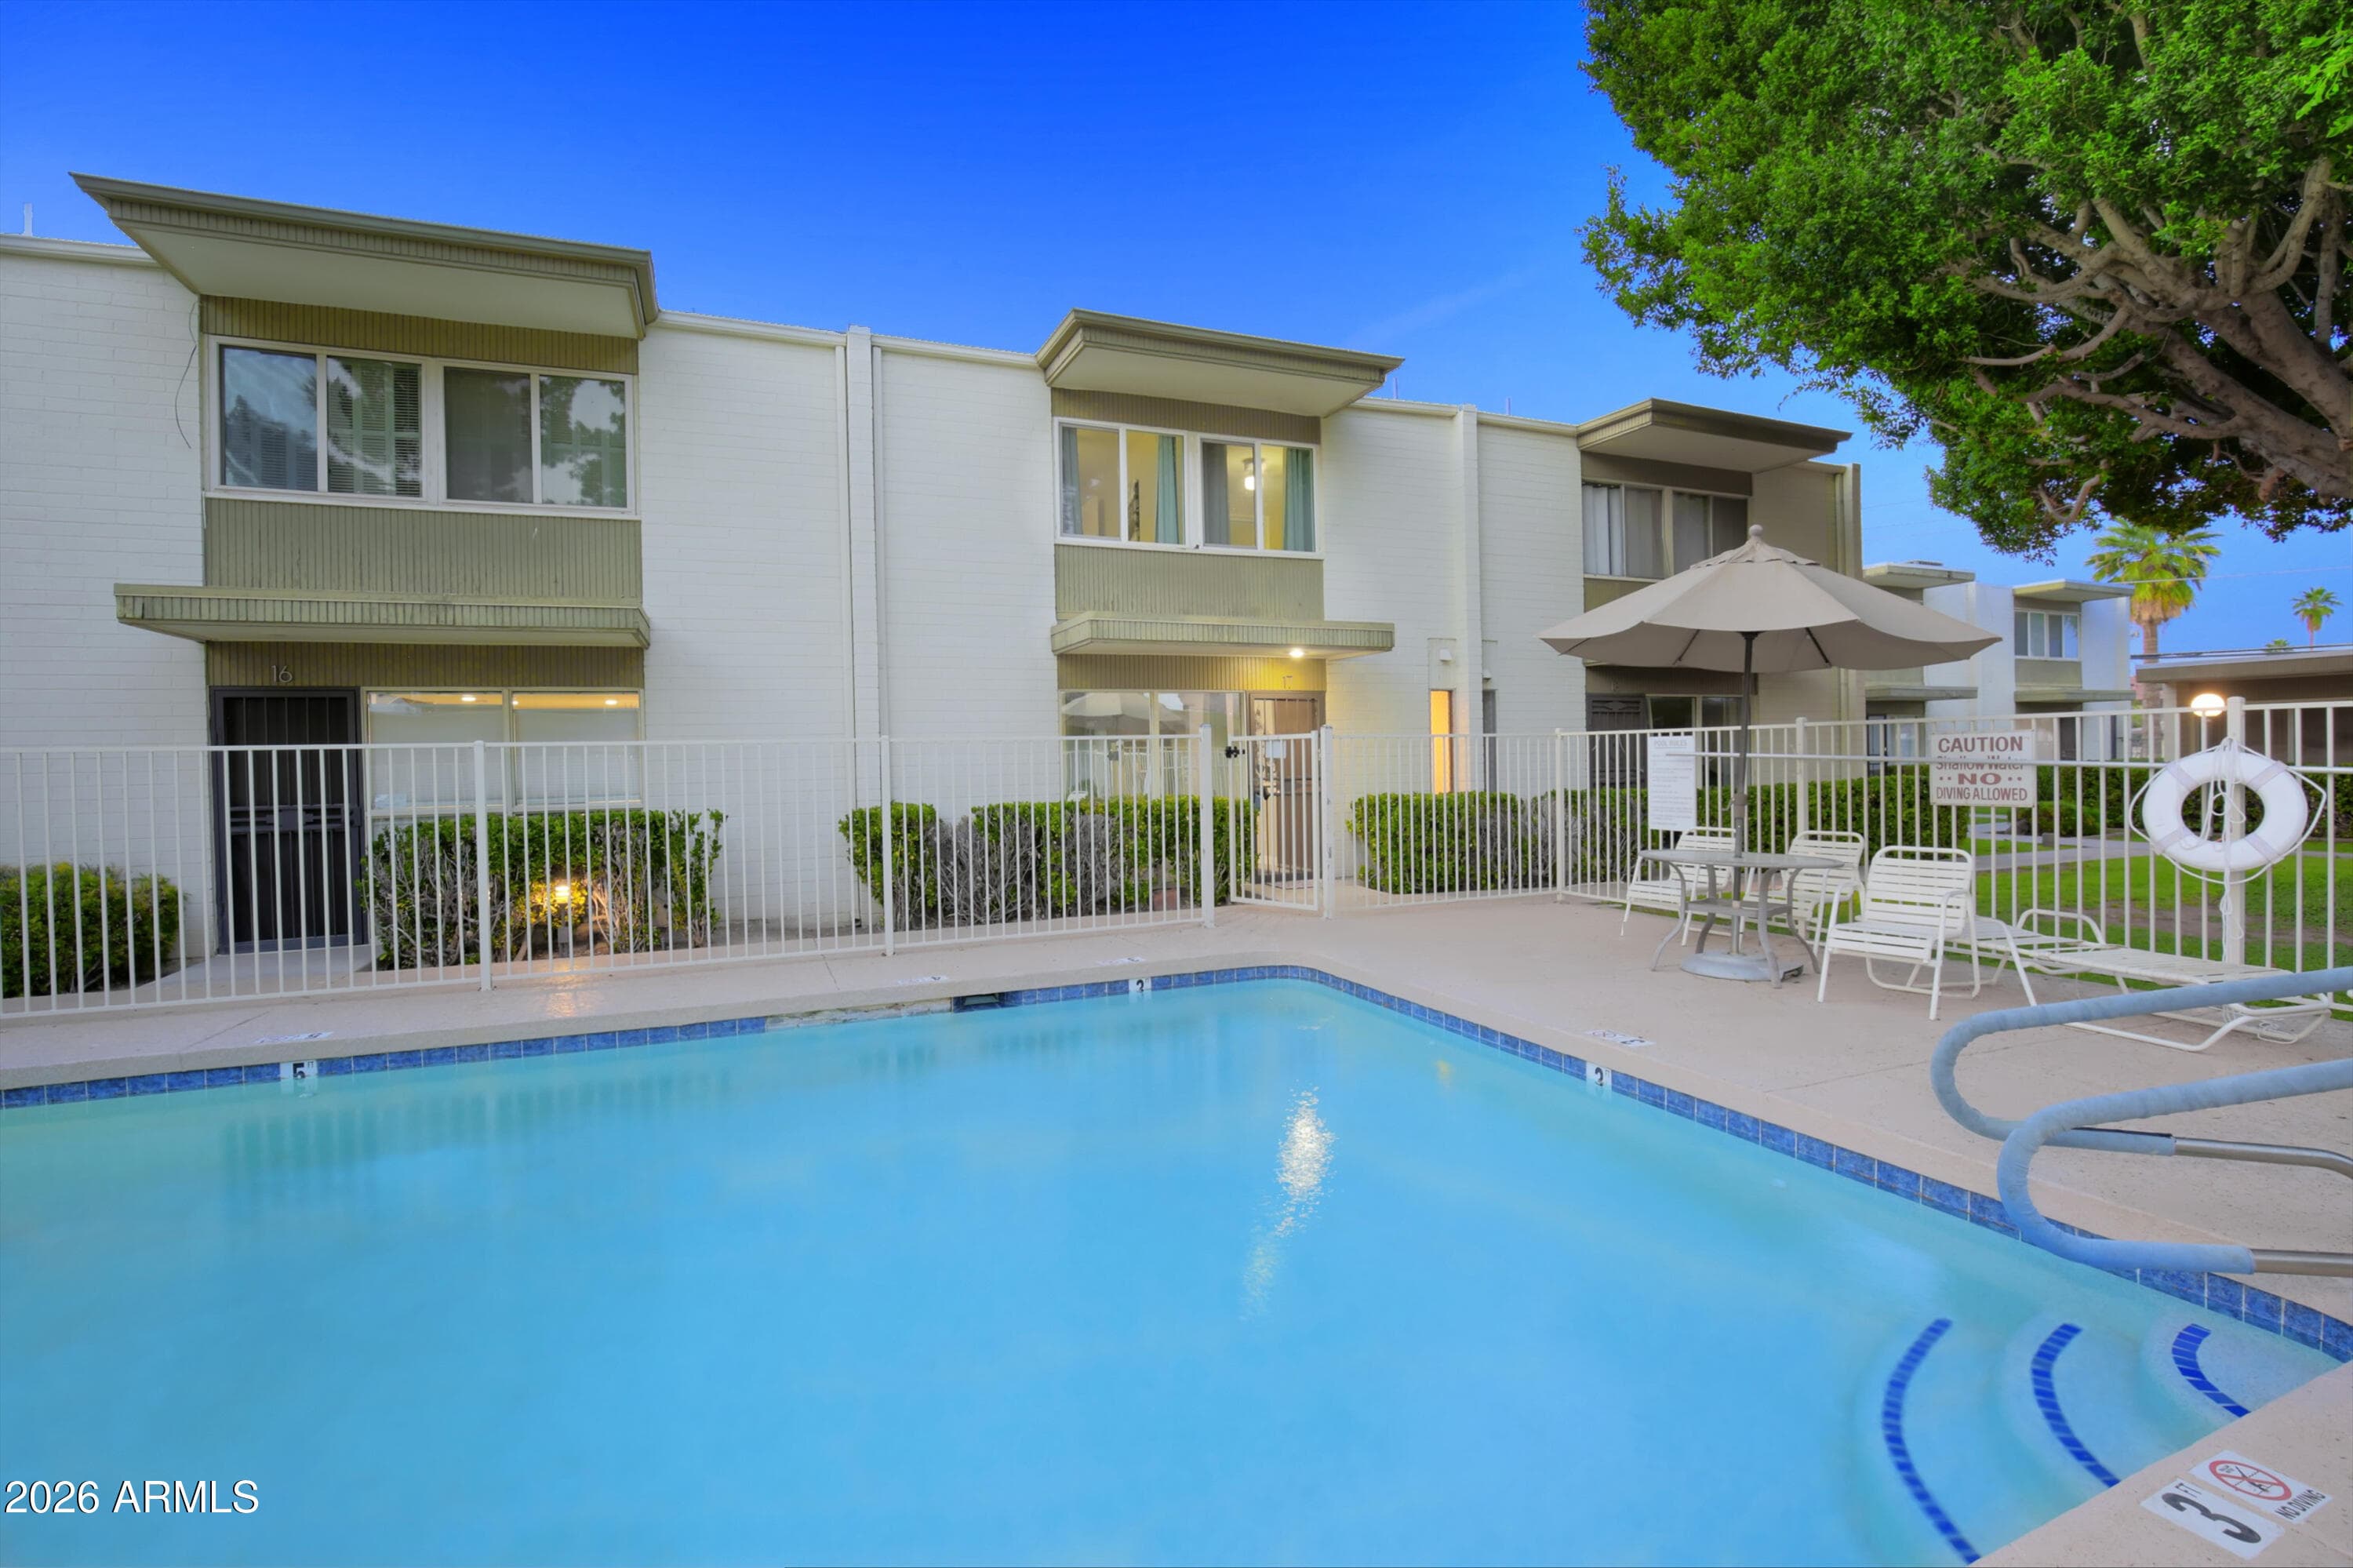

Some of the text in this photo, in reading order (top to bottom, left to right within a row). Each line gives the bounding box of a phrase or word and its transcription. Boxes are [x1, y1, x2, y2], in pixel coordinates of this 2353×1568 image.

[271, 665, 293, 683] 16
[1938, 736, 2023, 752] CAUTION
[1958, 773, 2002, 785] NO
[1936, 787, 2028, 800] DIVING ALLOWED
[293, 1062, 305, 1079] 5
[2275, 1489, 2326, 1520] NO DIVING
[2162, 1493, 2261, 1544] 3
